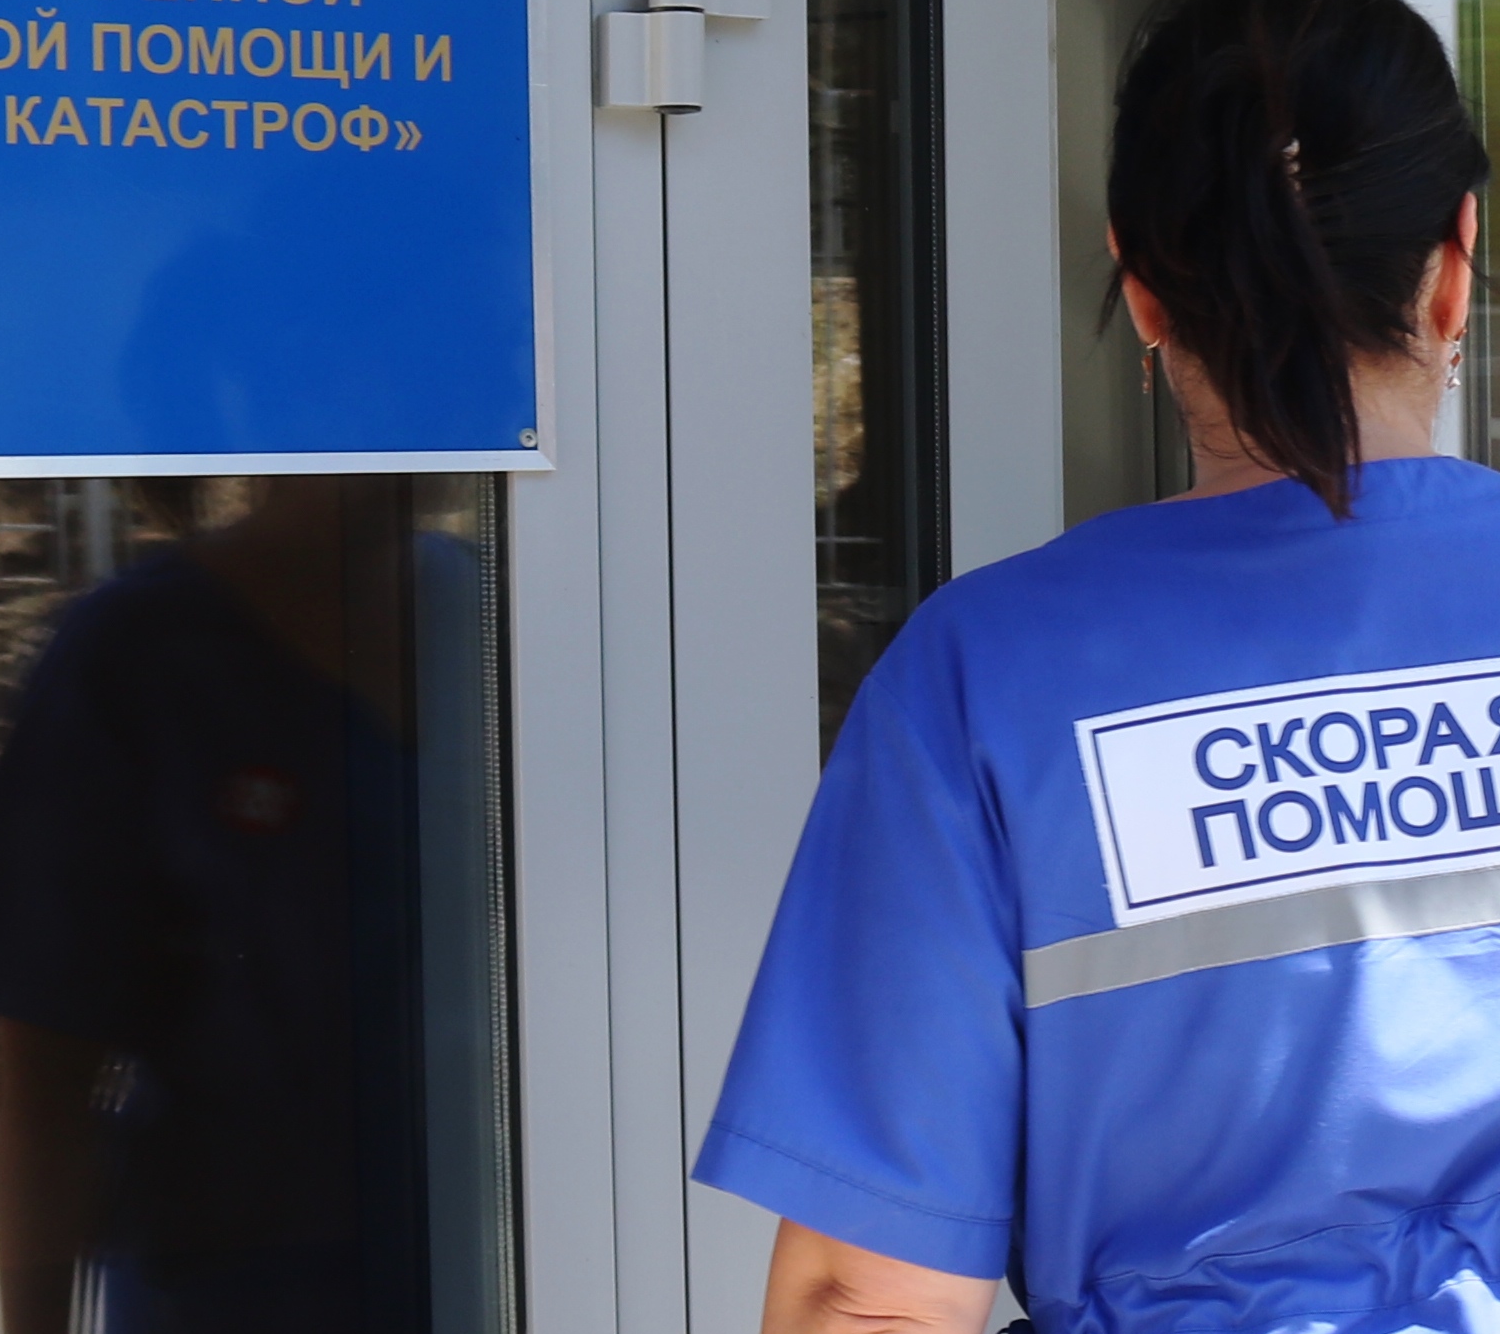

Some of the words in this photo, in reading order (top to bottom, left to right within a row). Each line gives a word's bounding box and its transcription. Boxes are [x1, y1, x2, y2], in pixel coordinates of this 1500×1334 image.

[92, 21, 392, 90] ПОМОЩИ
[414, 33, 453, 83] И
[5, 95, 423, 153] КАТАСТРОФ»
